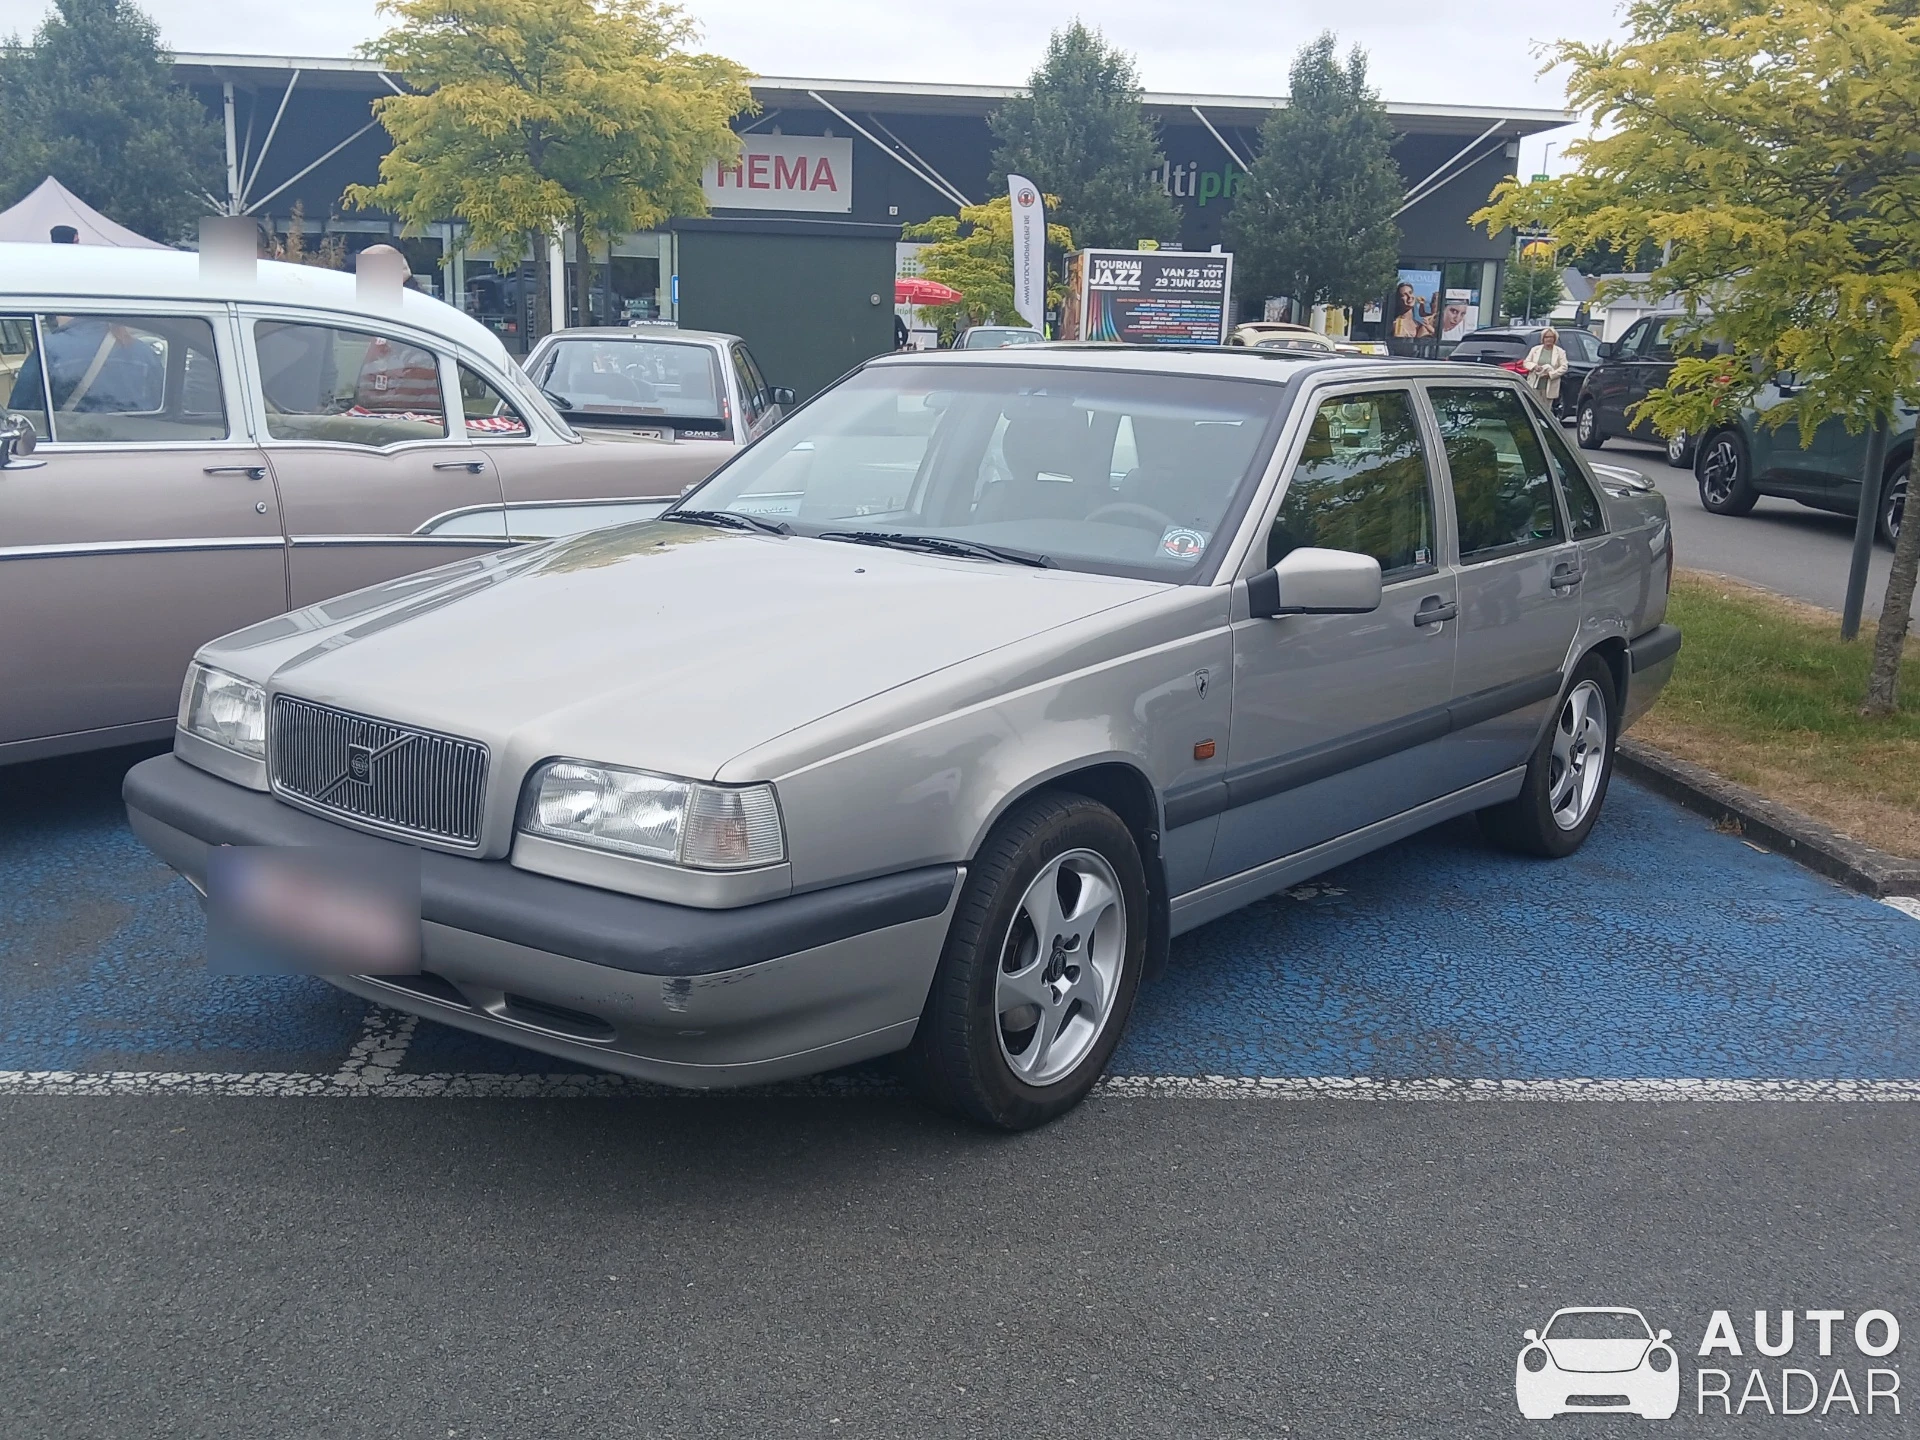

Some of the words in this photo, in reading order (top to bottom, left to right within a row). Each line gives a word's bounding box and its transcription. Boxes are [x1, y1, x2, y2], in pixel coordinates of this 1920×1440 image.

[717, 154, 838, 192] HEMA
[1094, 259, 1142, 270] TOURNAI
[1089, 269, 1142, 286] JAZZ
[1161, 267, 1185, 277] VAN
[1187, 268, 1200, 278] 25
[1201, 269, 1224, 279] TOT
[1155, 277, 1168, 287] 29
[1170, 278, 1195, 288] JUNI
[1197, 279, 1223, 289] 2025
